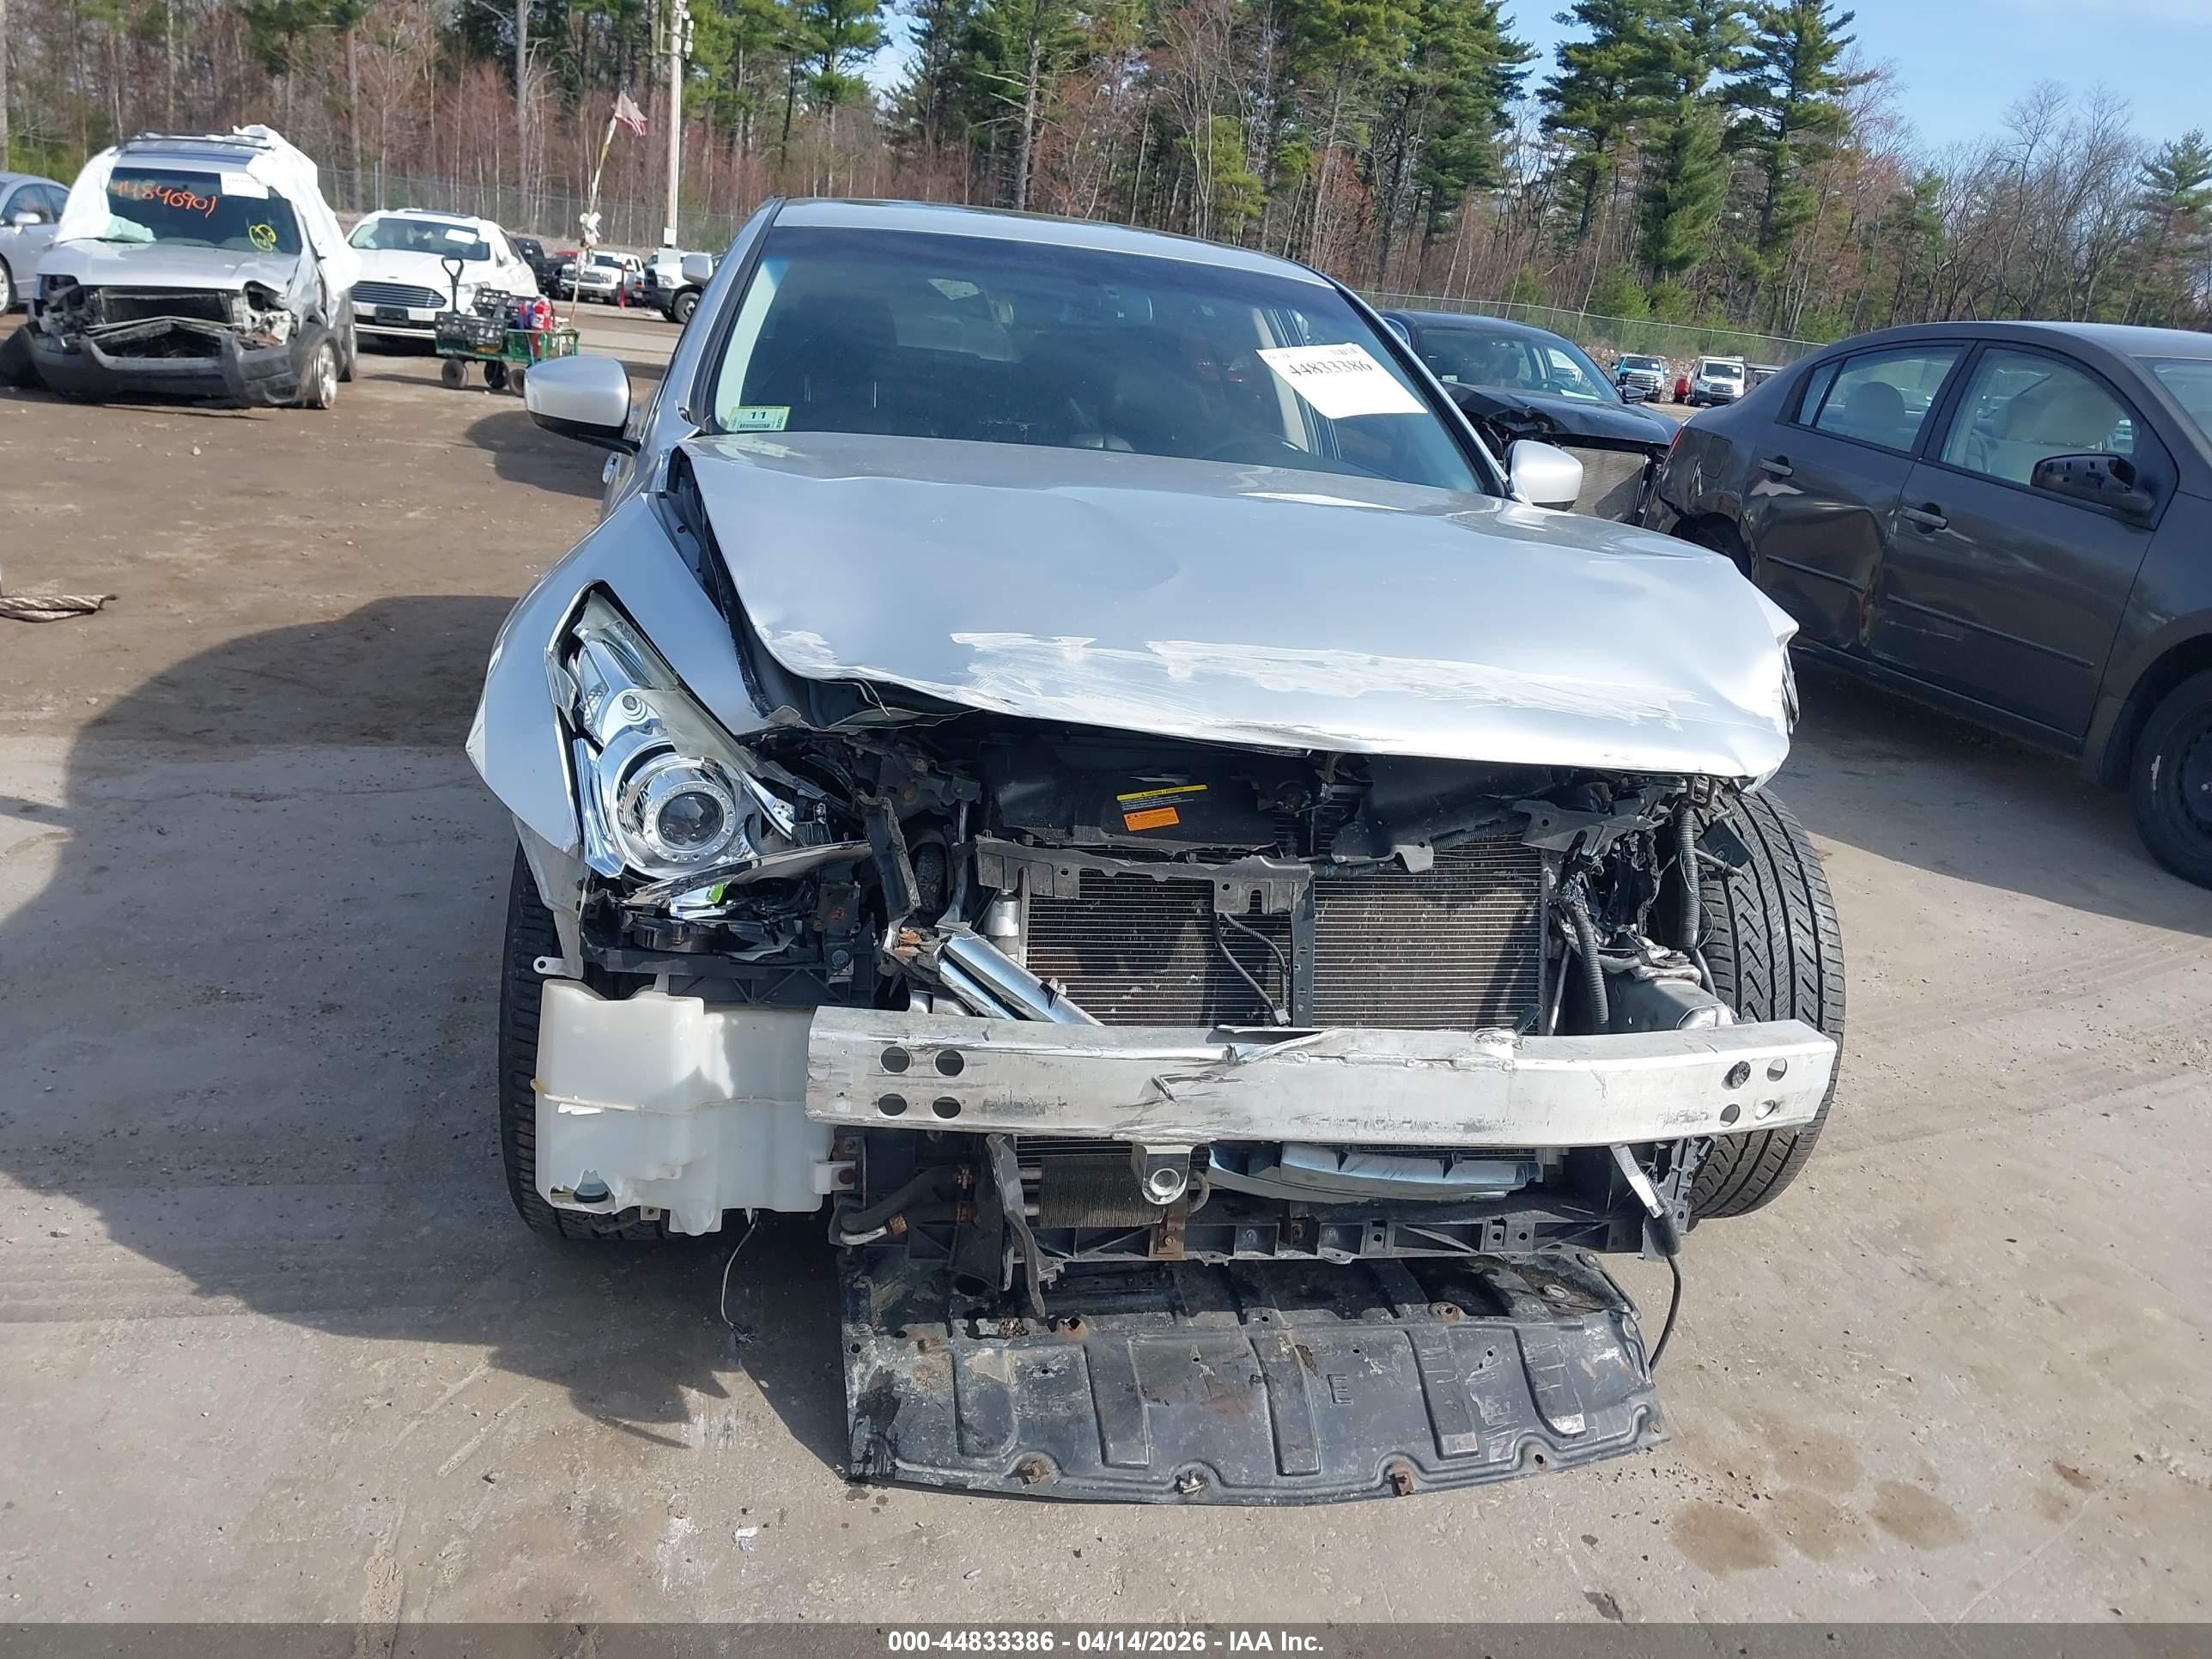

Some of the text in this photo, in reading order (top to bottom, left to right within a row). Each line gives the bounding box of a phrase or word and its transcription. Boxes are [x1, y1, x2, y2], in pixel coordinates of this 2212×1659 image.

[109, 179, 217, 219] 44846901
[1289, 359, 1374, 376] 44833386
[1327, 1373, 1353, 1405] E
